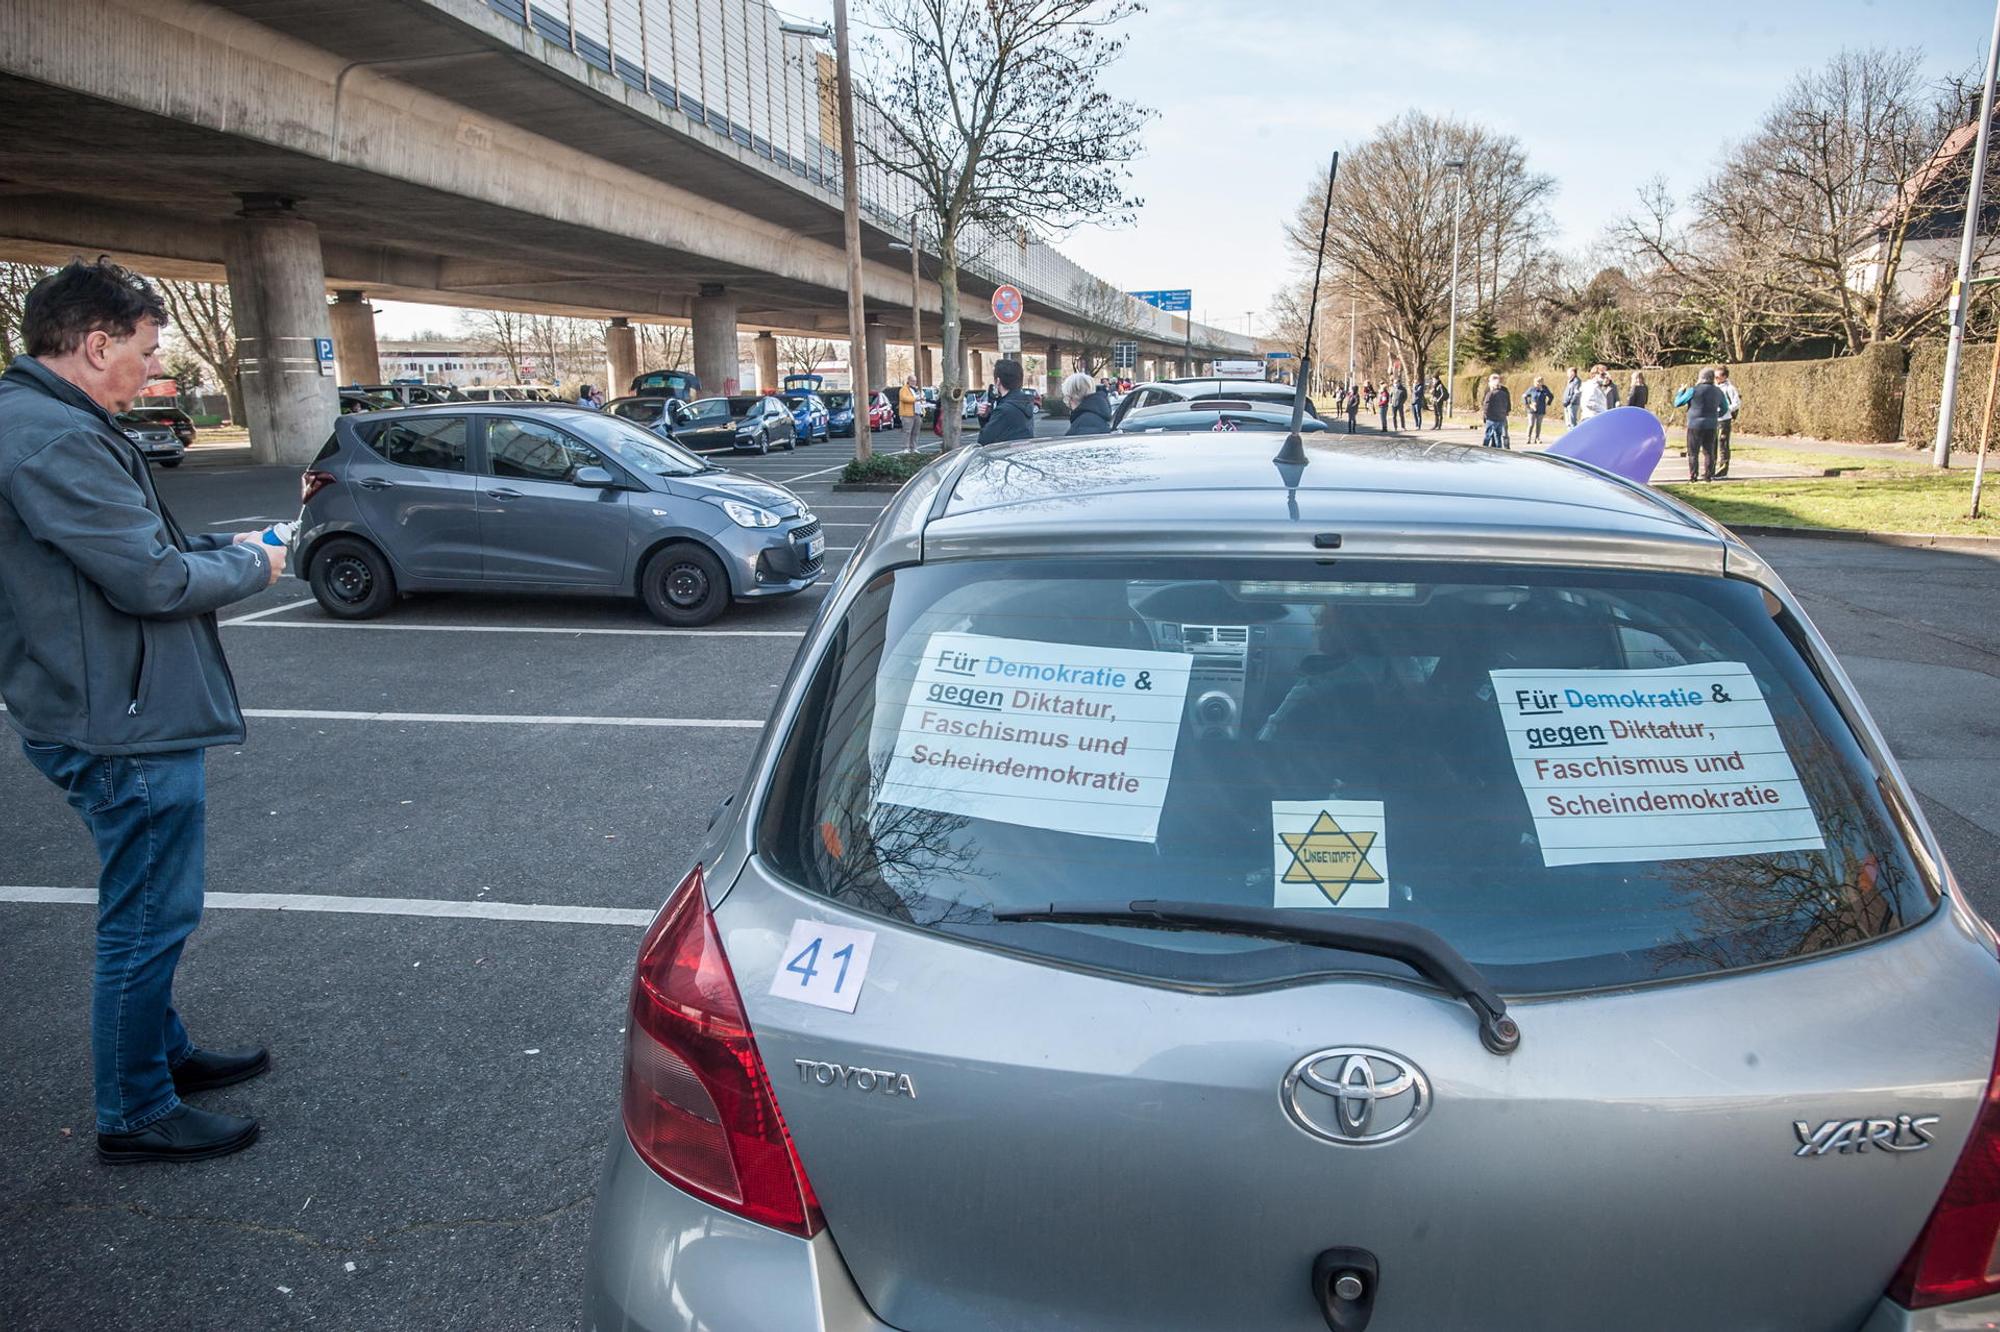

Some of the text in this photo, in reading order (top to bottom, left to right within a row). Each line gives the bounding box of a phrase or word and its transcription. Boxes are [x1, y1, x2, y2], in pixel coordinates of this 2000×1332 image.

[937, 650, 1153, 691] Für Demokratie &
[927, 682, 1116, 723] gegen Diktatur,
[1515, 683, 1732, 713] Für Demokratie &
[920, 711, 1128, 756] Faschismus und
[1526, 719, 1716, 749] gegen Diktatur,
[911, 744, 1140, 793] Scheindemokratie
[1535, 751, 1745, 780] Faschismus und
[1547, 785, 1780, 816] Scheindemokratie
[786, 938, 855, 993] 41
[794, 1058, 917, 1099] TOYOTA
